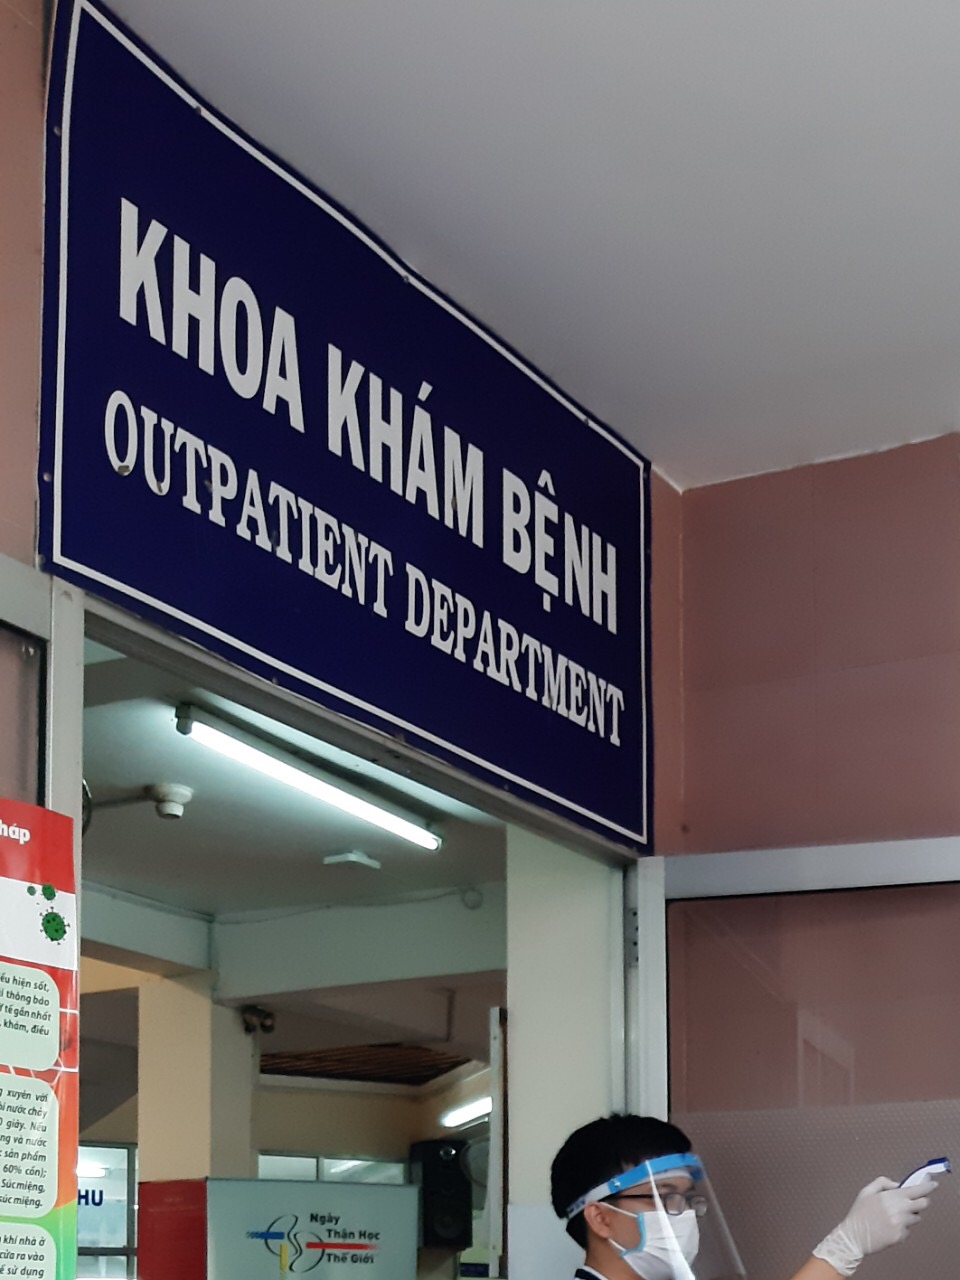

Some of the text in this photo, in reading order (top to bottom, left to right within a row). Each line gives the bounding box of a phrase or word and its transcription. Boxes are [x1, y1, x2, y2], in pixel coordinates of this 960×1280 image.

[119, 196, 618, 635] KHOA KHÁM BỆNH
[104, 390, 626, 748] OUTPATIENT DEPARTMENT
[6, 990, 32, 1006] thông
[309, 1212, 341, 1226] Ngày
[359, 1229, 381, 1242] Học
